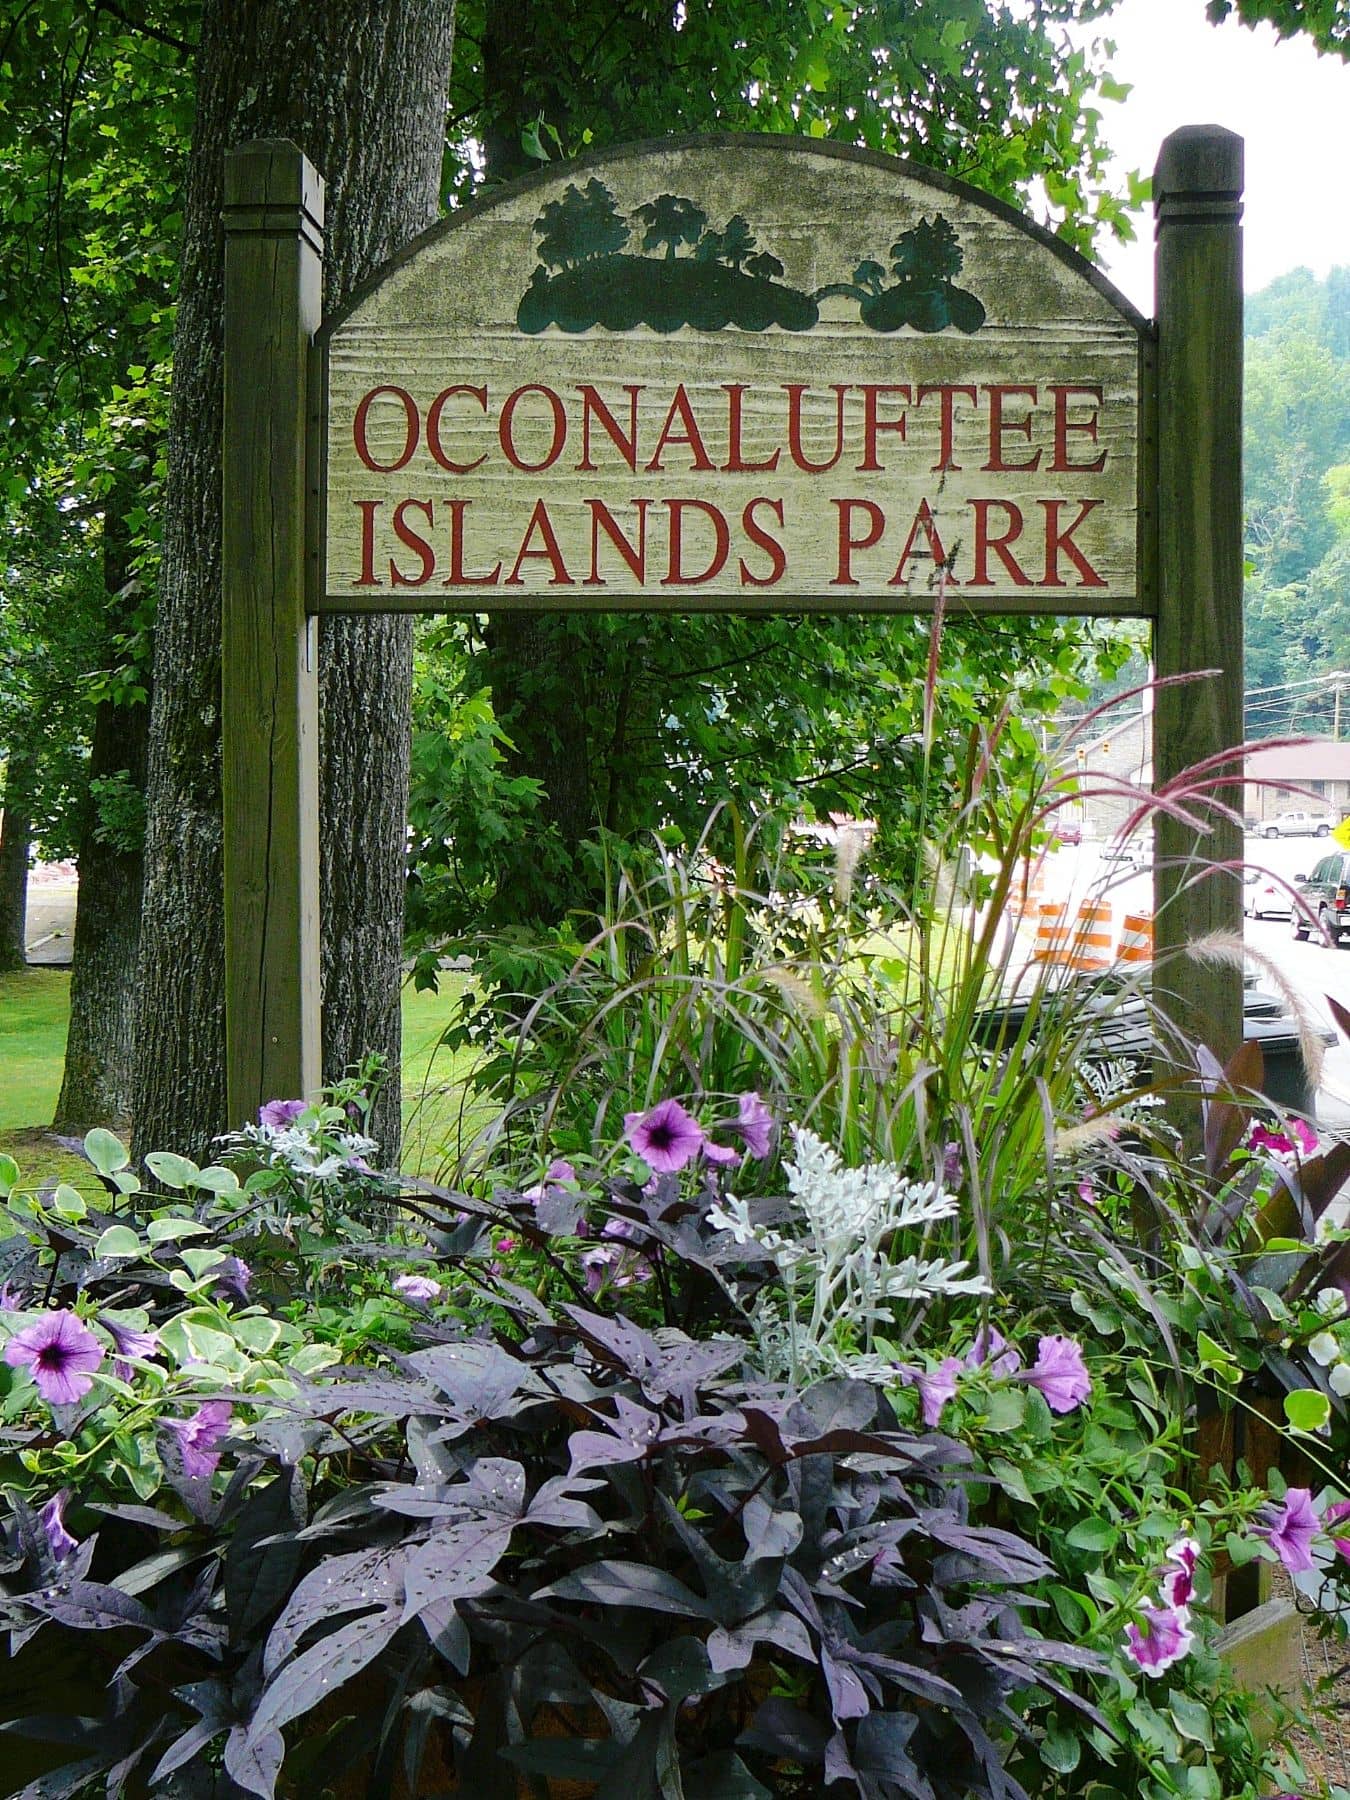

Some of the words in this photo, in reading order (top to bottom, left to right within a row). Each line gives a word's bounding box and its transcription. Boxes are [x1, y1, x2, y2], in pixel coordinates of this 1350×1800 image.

[353, 384, 1108, 473] OCONALUFTEE
[352, 497, 785, 587] ISLANDS
[829, 497, 1108, 587] PARK
